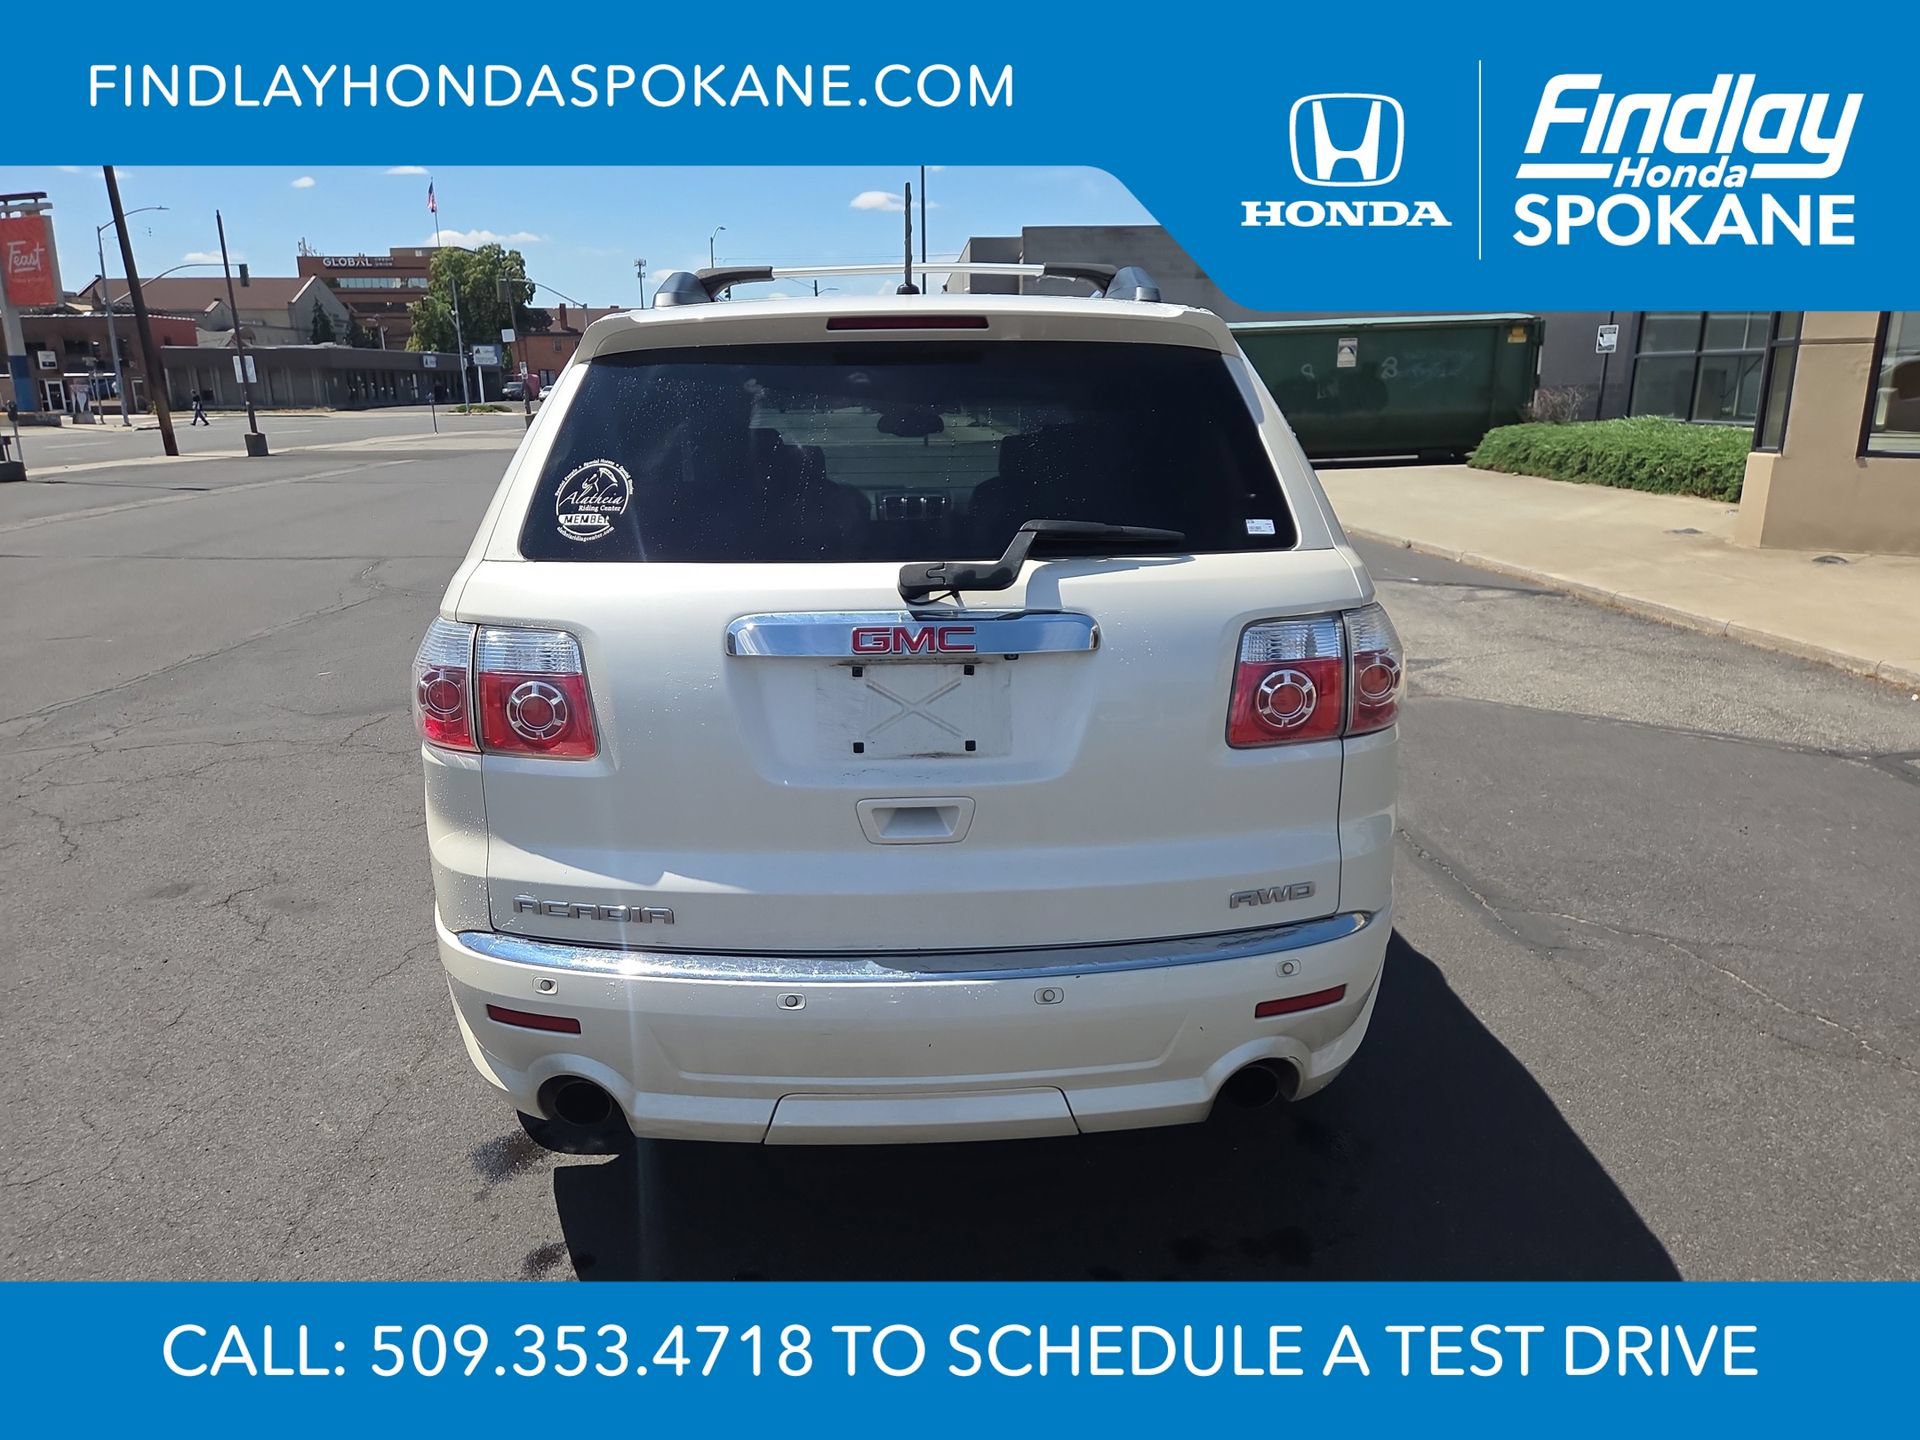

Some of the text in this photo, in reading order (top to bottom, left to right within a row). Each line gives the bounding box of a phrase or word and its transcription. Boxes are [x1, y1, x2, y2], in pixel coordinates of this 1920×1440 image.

[7, 241, 45, 274] Feast
[322, 257, 373, 268] GLOBAL
[559, 491, 624, 507] Alatheia
[578, 505, 599, 513] Riding
[851, 626, 976, 655] GMC
[1229, 881, 1316, 909] AWD
[513, 894, 675, 925] ACADIA
